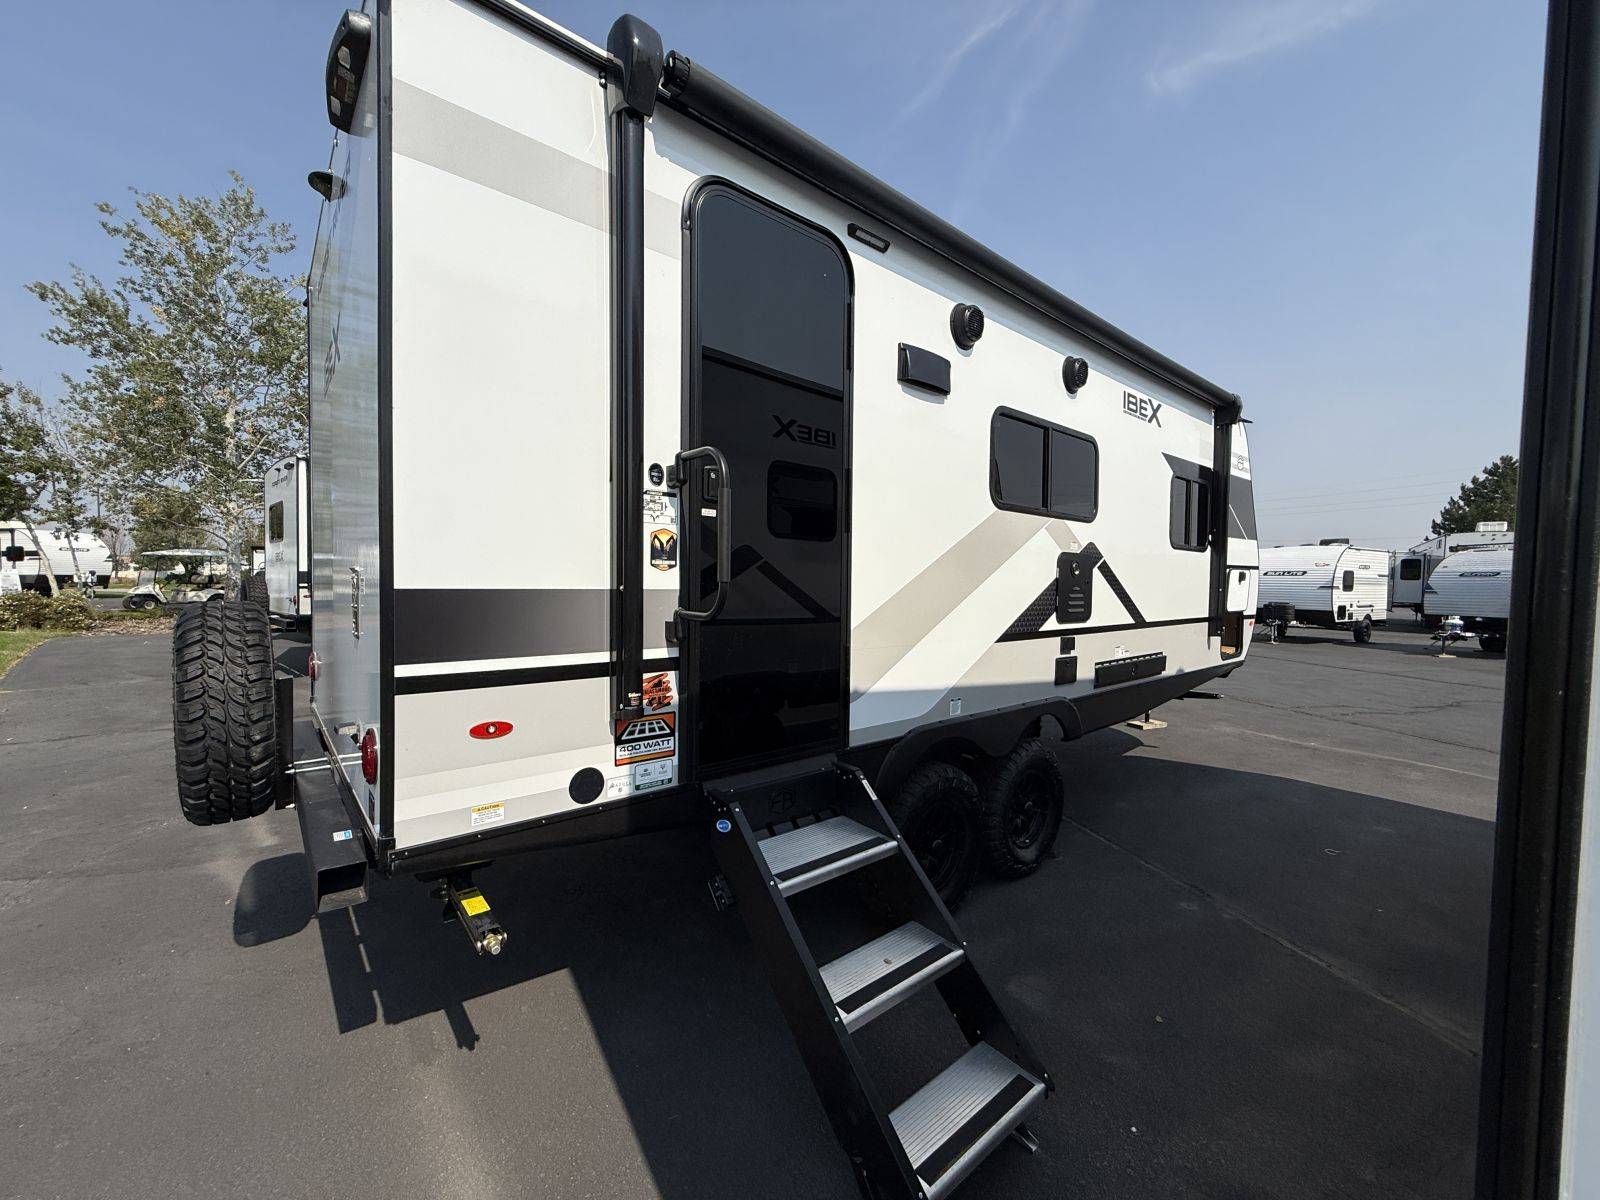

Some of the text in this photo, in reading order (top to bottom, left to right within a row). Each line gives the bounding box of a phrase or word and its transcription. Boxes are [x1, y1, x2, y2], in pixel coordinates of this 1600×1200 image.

[1123, 390, 1162, 428] IBEX
[619, 743, 641, 753] 400
[643, 738, 672, 749] WATT
